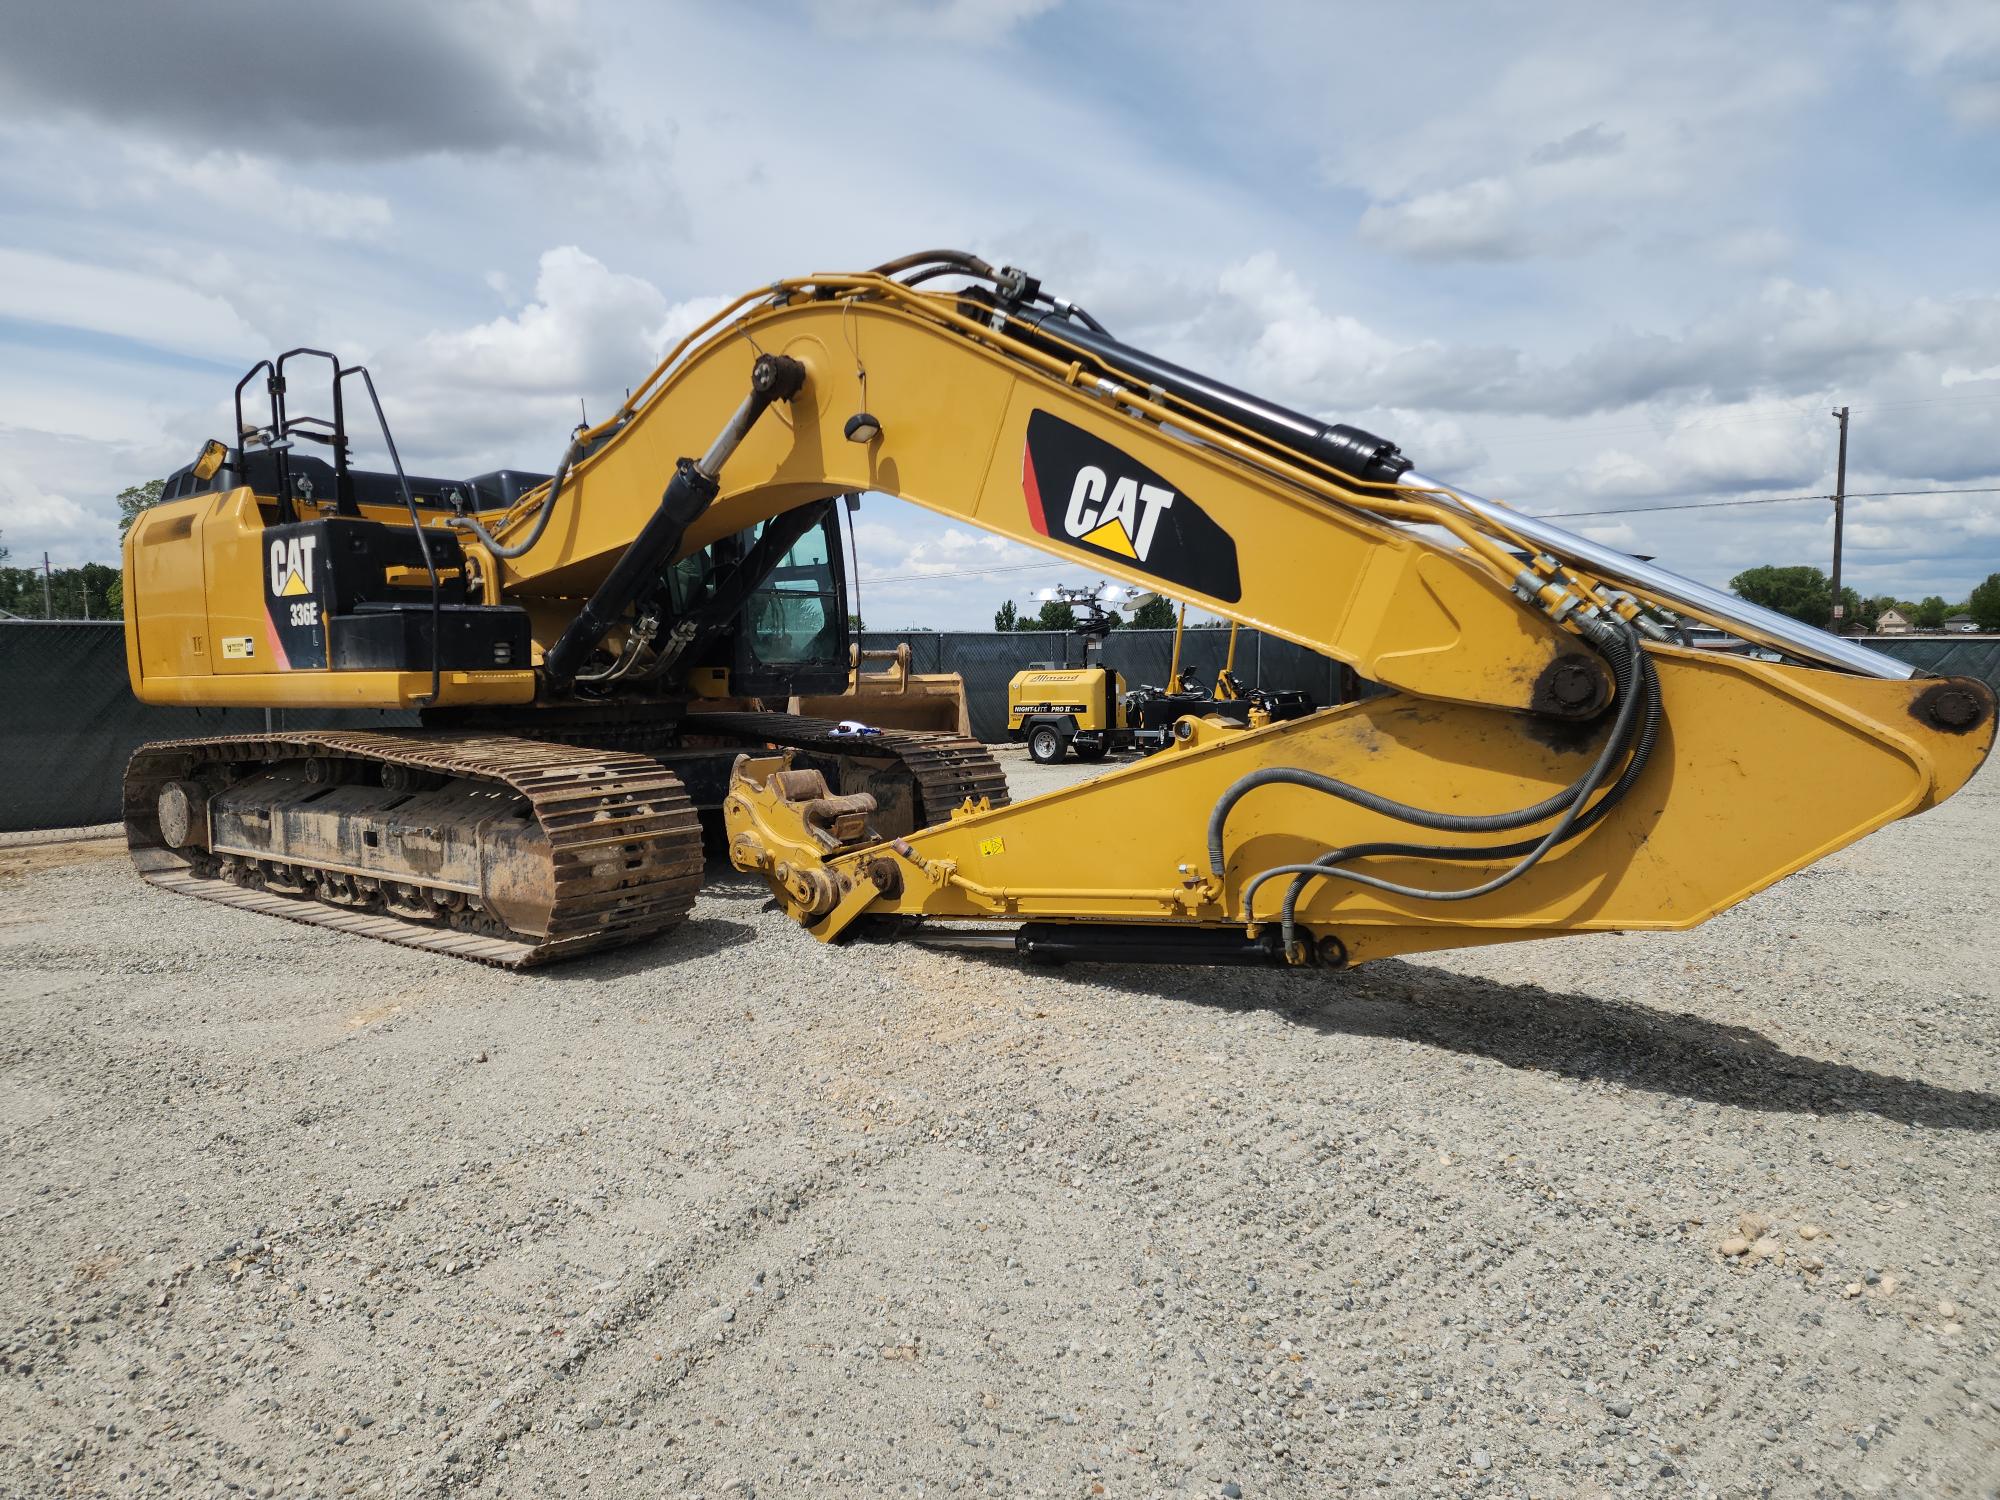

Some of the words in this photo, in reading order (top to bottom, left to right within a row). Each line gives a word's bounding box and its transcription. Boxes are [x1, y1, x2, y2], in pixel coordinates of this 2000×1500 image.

[1064, 465, 1175, 562] CAT
[270, 535, 316, 597] CAT
[290, 602, 318, 627] 336E
